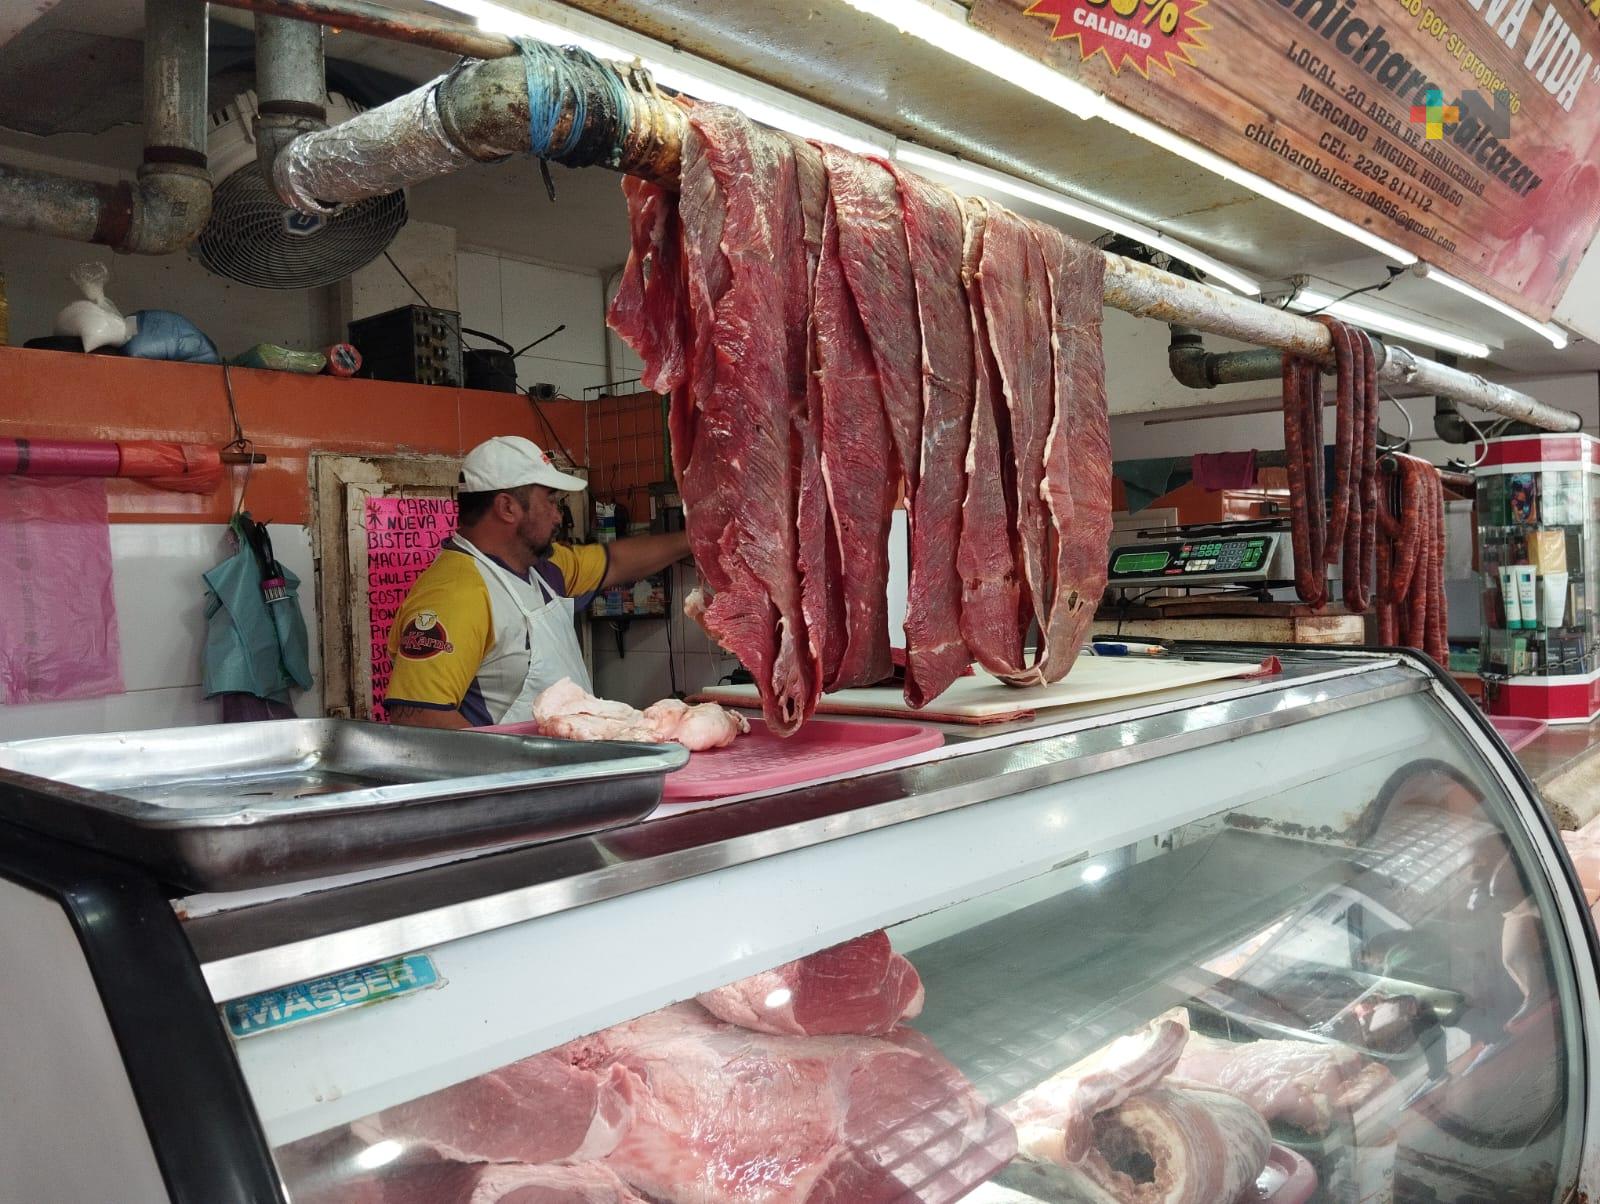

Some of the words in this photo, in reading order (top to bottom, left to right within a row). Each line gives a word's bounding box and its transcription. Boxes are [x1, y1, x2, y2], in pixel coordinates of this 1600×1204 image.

[1073, 7, 1152, 49] CALIDAD
[1418, 7, 1448, 40] por
[1446, 32, 1466, 59] su
[1459, 49, 1521, 114] propietario
[1286, 39, 1337, 91] LOCAL
[1366, 101, 1402, 137] AREA
[1403, 127, 1421, 150] DE
[1420, 140, 1486, 198] CARNICERIAS
[1296, 83, 1369, 143] MERCADO
[1372, 136, 1420, 178] MIGUEL
[1419, 168, 1464, 208] HIDALGO
[1318, 131, 1351, 163] CEL:
[1353, 154, 1389, 186] 2292
[387, 515, 437, 530] NUEVA
[397, 498, 460, 515] CARNICE
[367, 531, 420, 549] BISTEC
[367, 551, 423, 569] MACIZA
[234, 963, 418, 1030] MASSER
